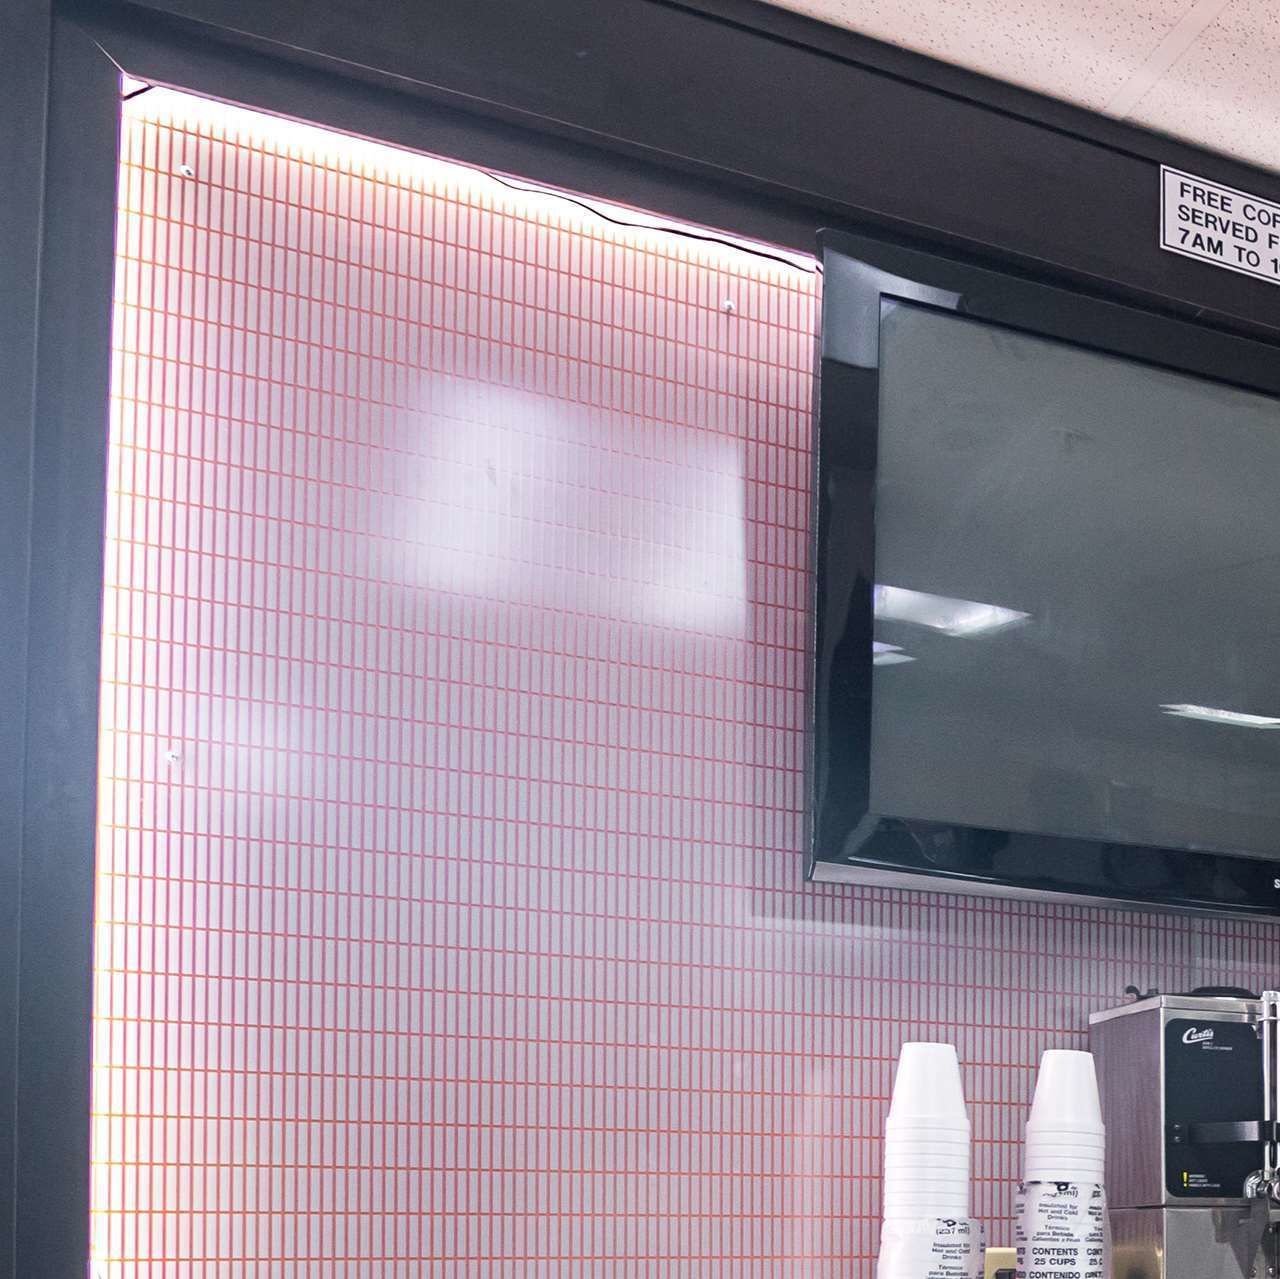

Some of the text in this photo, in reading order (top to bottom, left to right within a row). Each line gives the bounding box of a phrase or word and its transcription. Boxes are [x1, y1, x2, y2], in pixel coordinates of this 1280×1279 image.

[1180, 181, 1232, 214] FREE
[1178, 204, 1258, 243] SERVED
[1178, 227, 1223, 256] 7AM
[1233, 244, 1260, 267] TO
[1182, 1027, 1214, 1044] Curtis
[1032, 1248, 1079, 1256] CONTENTS
[1034, 1258, 1077, 1266] 25 CUPS
[1029, 1271, 1081, 1279] CONTENIDO
